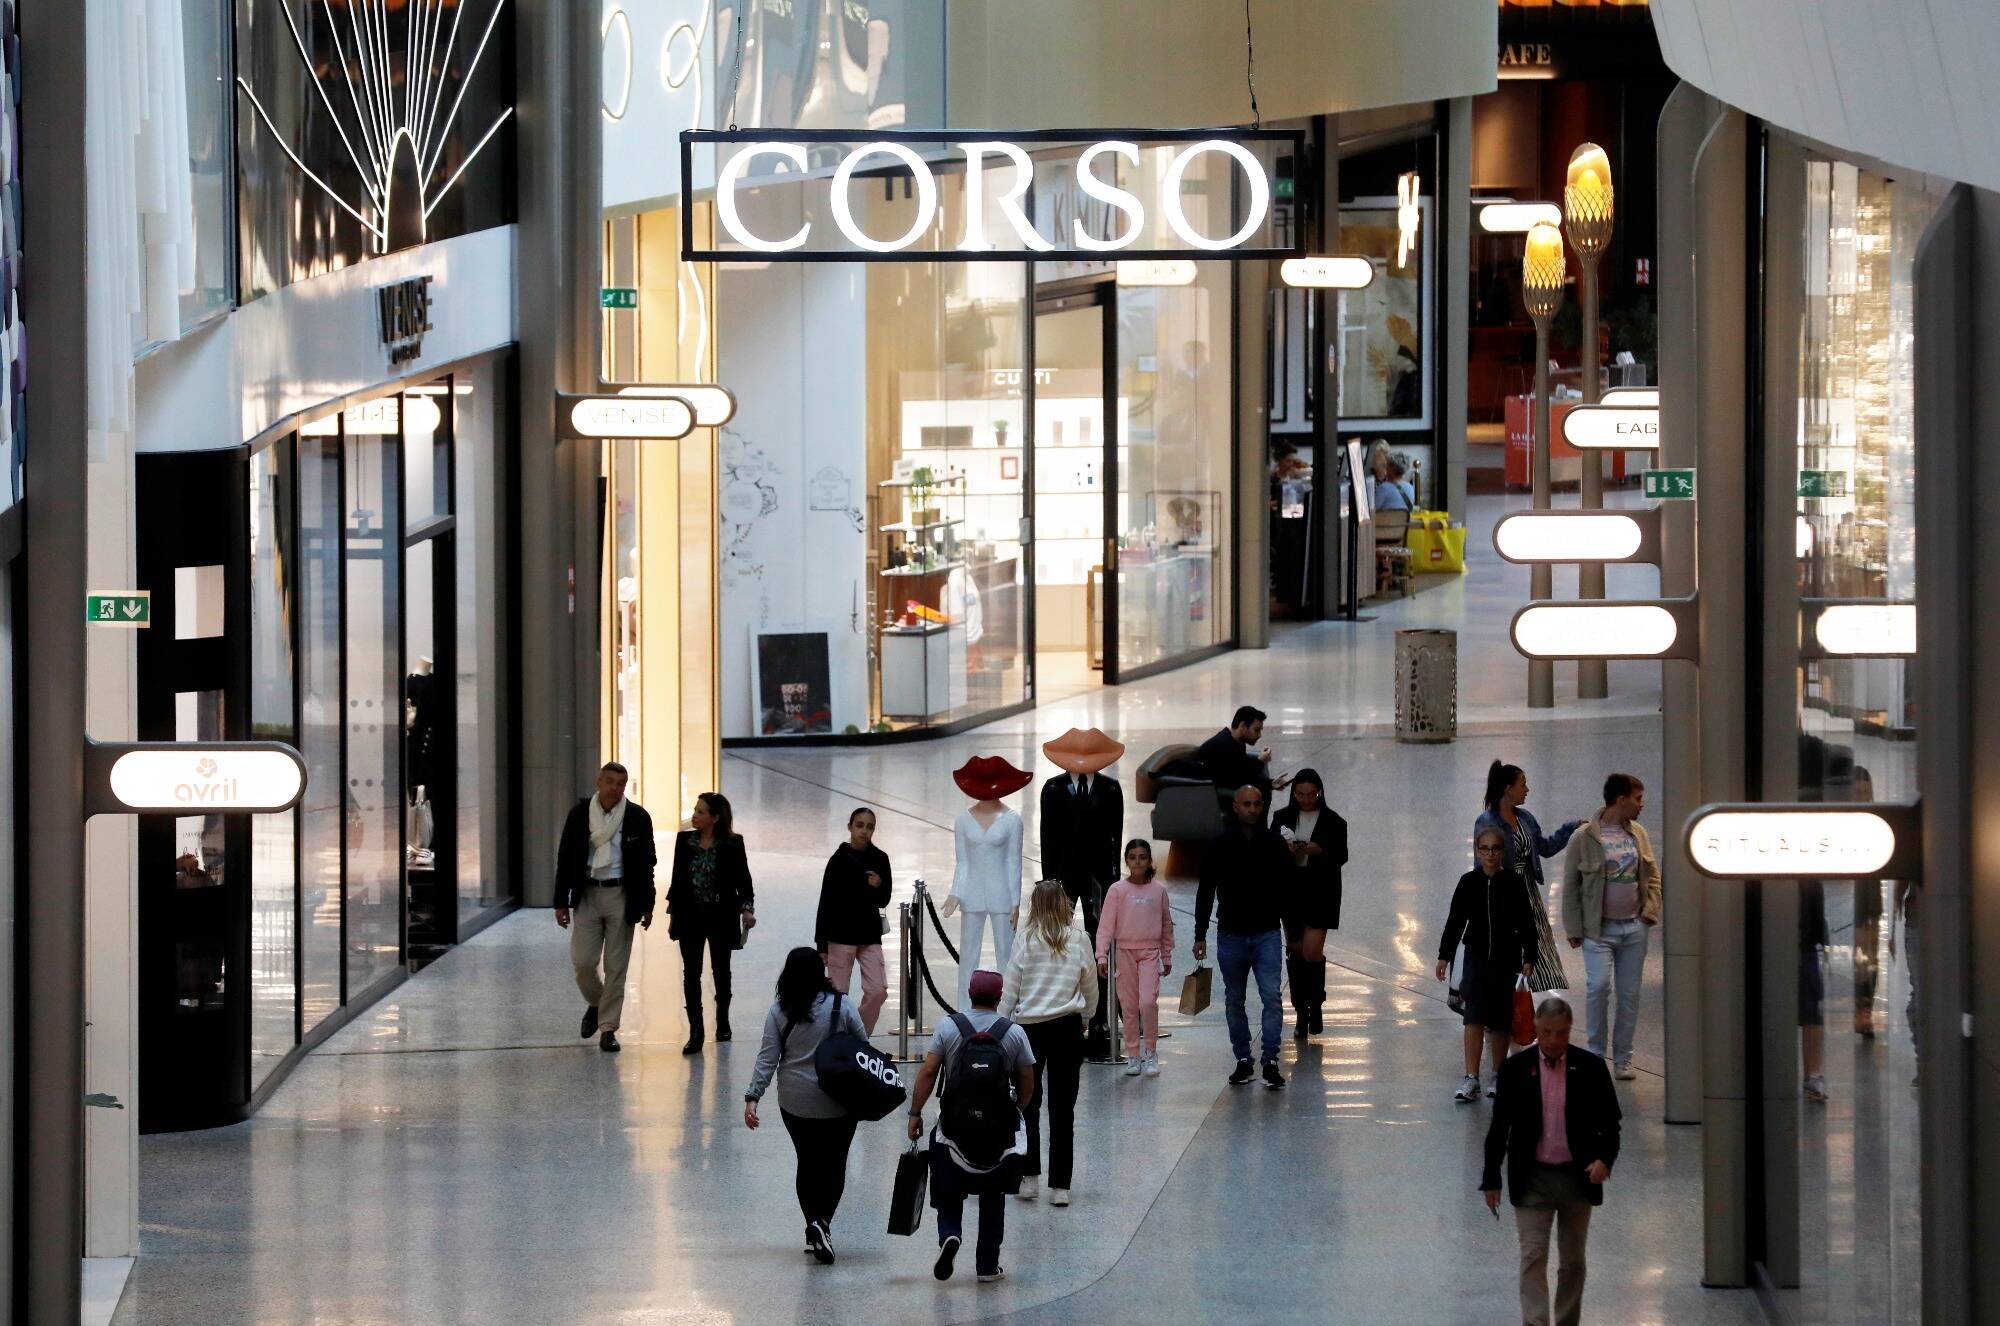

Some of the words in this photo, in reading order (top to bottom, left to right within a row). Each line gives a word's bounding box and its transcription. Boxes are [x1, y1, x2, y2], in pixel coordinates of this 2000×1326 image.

[1498, 43, 1552, 65] AFE
[717, 140, 1270, 252] CORSO
[379, 275, 434, 343] VENISE
[588, 407, 675, 425] VENISE
[174, 777, 238, 802] avril
